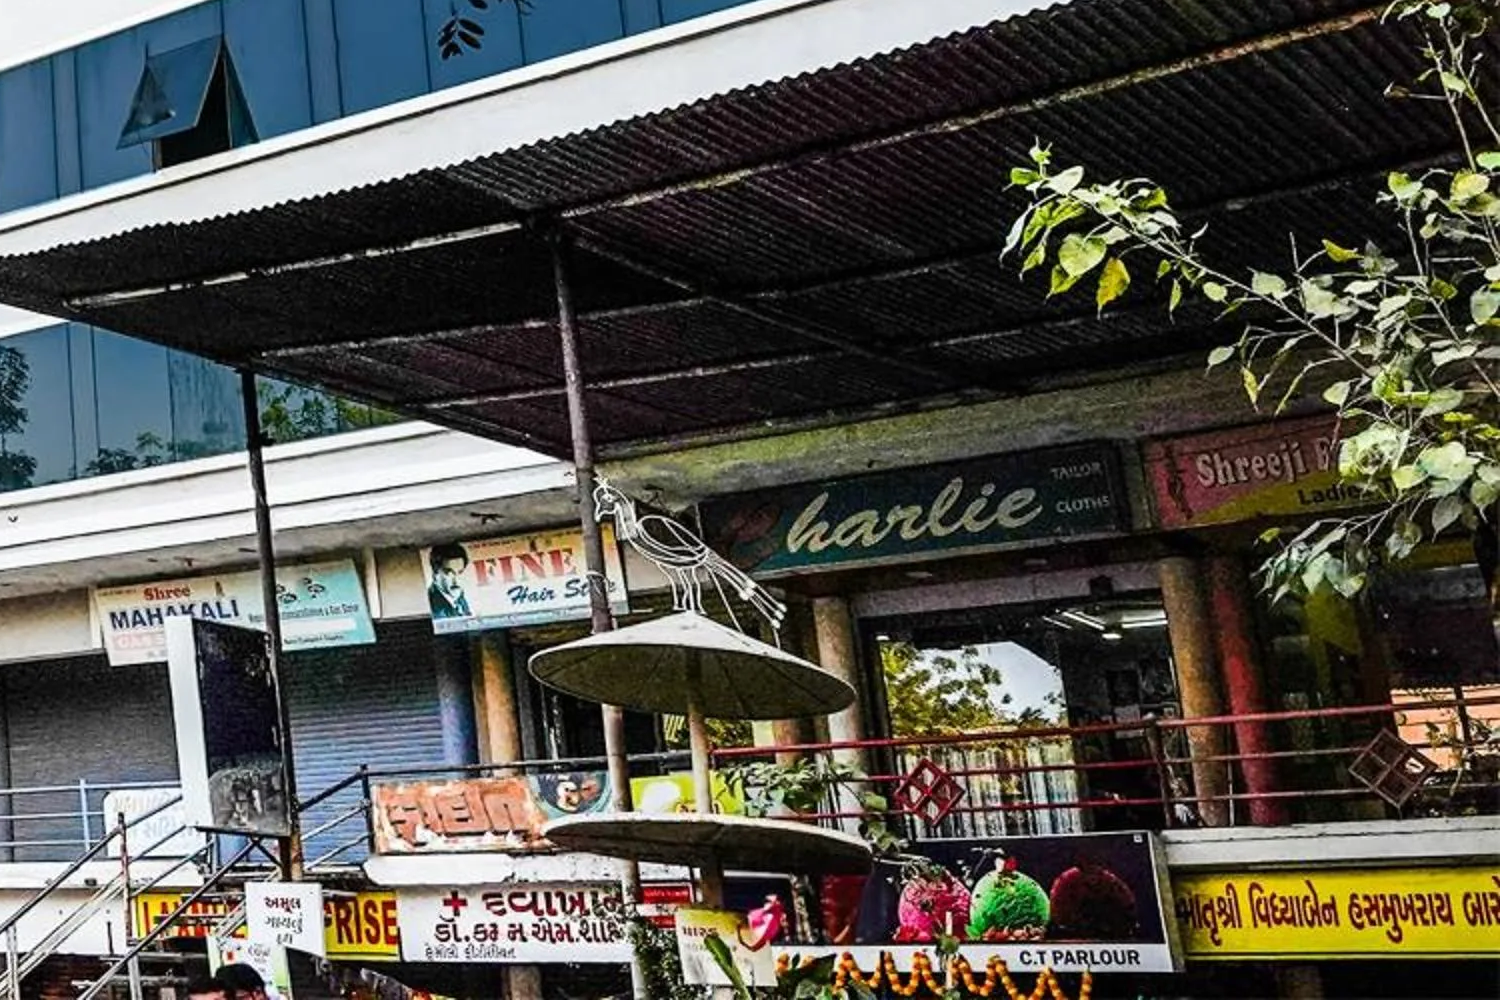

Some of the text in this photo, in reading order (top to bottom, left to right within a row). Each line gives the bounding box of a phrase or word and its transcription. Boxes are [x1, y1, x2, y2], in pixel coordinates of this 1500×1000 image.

[1196, 441, 1306, 488] Shreeji
[473, 547, 576, 587] FINE
[143, 584, 191, 601] Shree
[507, 584, 556, 605] Hair
[109, 599, 239, 629] MAHAKALI
[1052, 948, 1141, 968] PARLOUR
